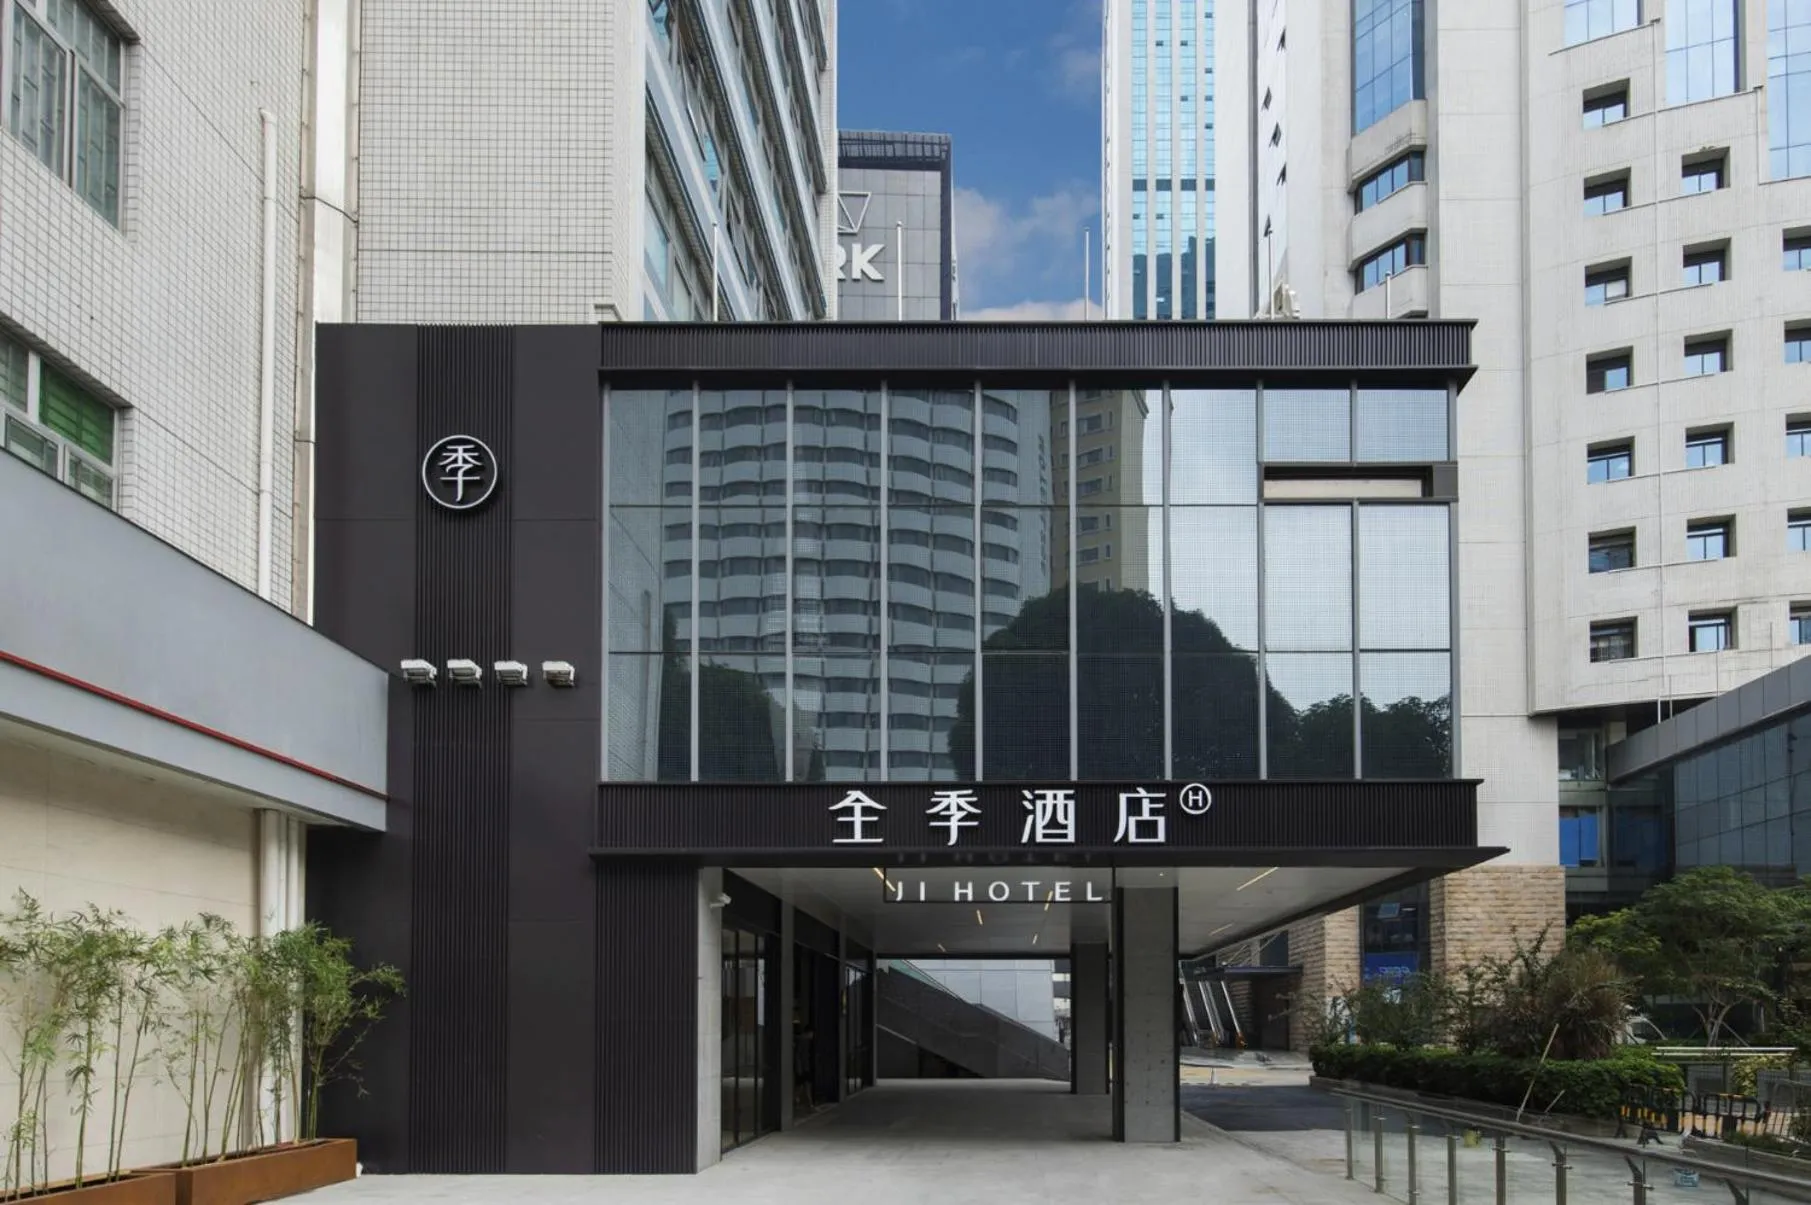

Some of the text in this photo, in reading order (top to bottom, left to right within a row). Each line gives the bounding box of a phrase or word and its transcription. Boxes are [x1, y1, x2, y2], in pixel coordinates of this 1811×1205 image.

[436, 442, 485, 504] 季
[828, 787, 1168, 847] 全季酒店
[896, 881, 1104, 902] JI HOTEL
